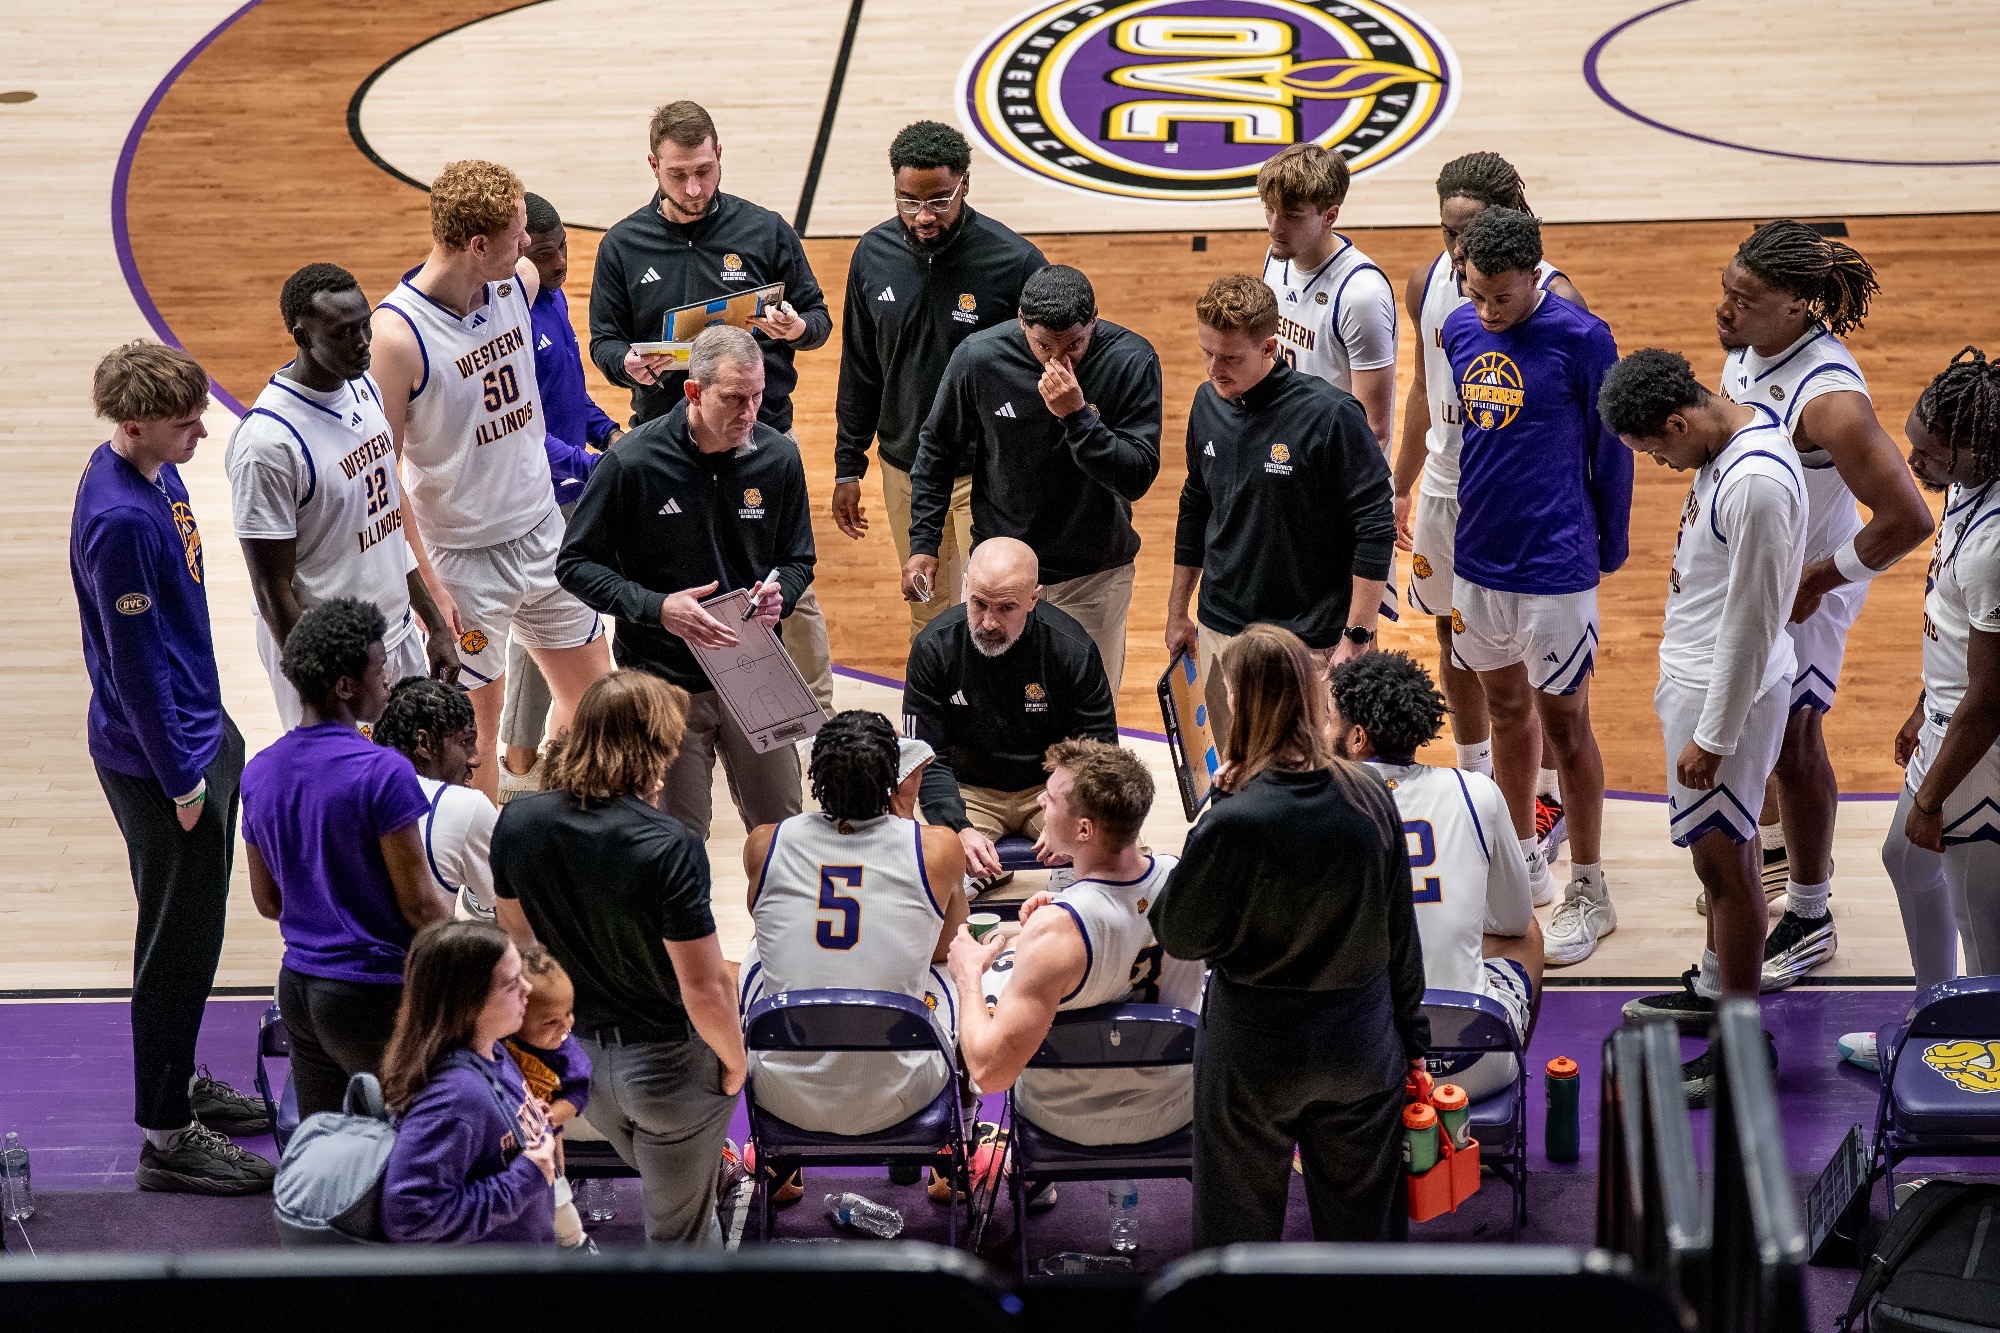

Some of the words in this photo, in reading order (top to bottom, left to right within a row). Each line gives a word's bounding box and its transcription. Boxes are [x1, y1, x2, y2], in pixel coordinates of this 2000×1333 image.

[1312, 0, 1397, 47] HIO
[1003, 4, 1105, 167] CONFERENCE
[1108, 15, 1294, 145] OVC
[1334, 94, 1409, 153] VALL
[454, 326, 525, 381] WESTERN
[1276, 315, 1316, 352] ESTERN
[482, 363, 521, 414] 50
[1461, 383, 1525, 407] LEATHERNECK
[1472, 401, 1506, 412] BASKETBALL
[476, 400, 534, 448] ILLINOIS
[338, 430, 393, 481] WESTERN
[364, 466, 390, 519] 22
[356, 507, 403, 554] ILLINOIS
[123, 599, 143, 610] OVC
[815, 863, 865, 952] 5
